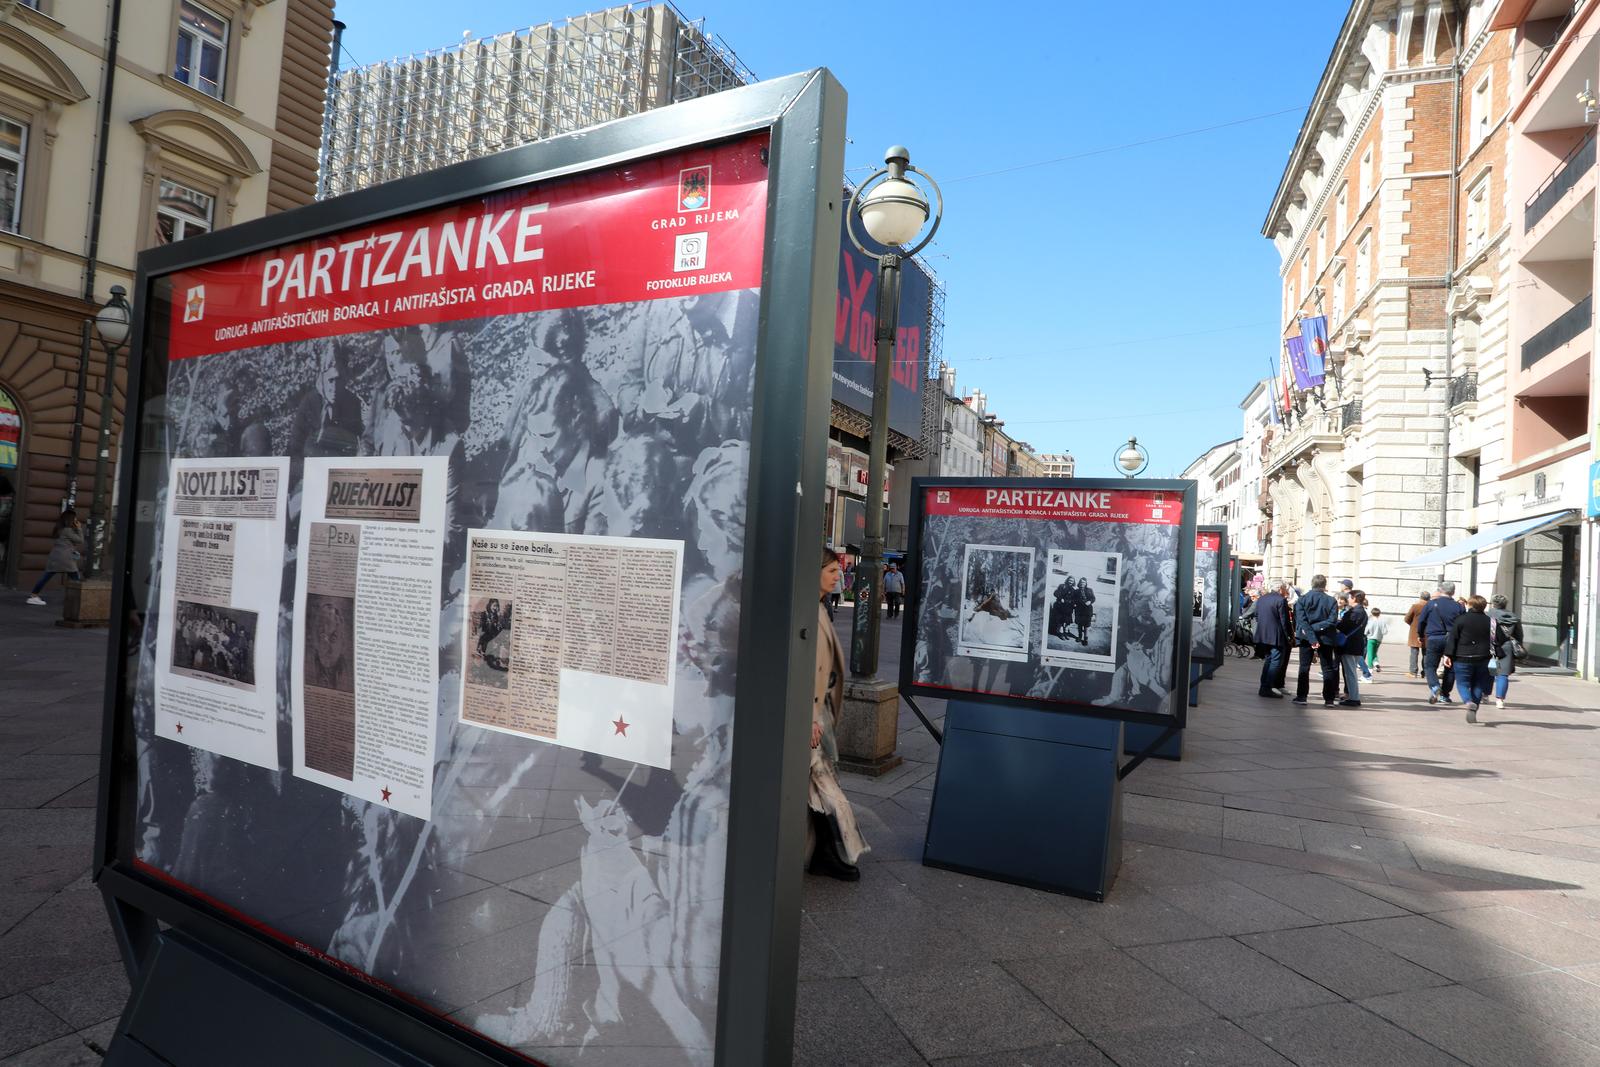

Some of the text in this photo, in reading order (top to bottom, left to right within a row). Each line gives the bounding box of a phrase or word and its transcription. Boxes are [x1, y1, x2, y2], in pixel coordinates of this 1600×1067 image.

[651, 209, 739, 230] GRAD RIJEKA
[646, 272, 732, 291] FOTOKLUB RIJEKA
[215, 270, 596, 342] UDRUGA ANTIFAŠISTIČKIH BORACA I ANTIFAŠISTA GRADA RIJEKE
[176, 471, 217, 495] NOVI
[220, 470, 259, 495] LIST
[383, 482, 418, 507] LIST
[1052, 509, 1086, 517] ANTIFAŠISTA
[511, 541, 529, 552] žene
